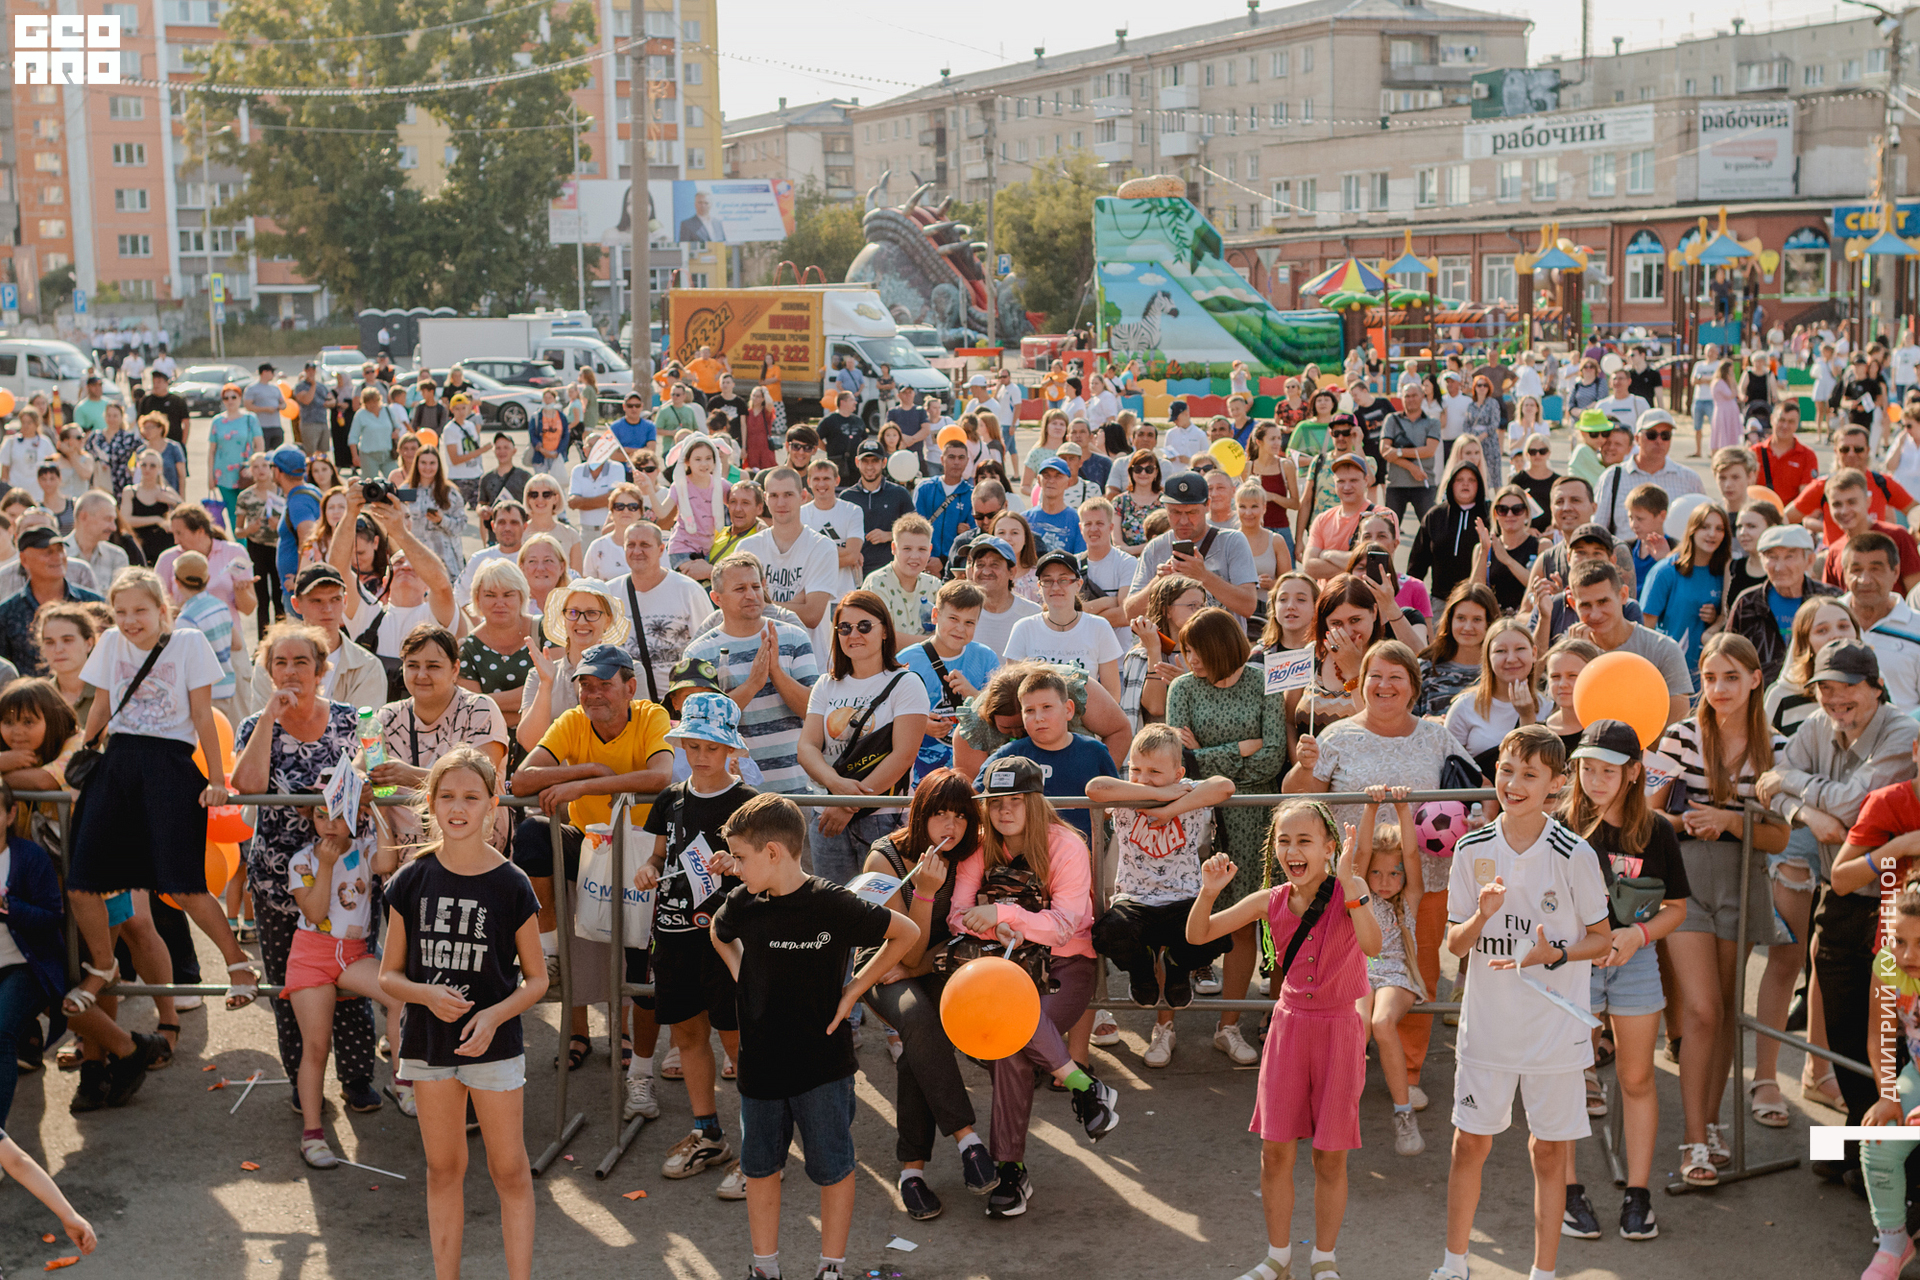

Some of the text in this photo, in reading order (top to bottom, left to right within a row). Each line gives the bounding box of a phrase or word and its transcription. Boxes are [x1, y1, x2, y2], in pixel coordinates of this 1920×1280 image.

[1702, 108, 1788, 132] рабочий
[1491, 117, 1607, 154] рабочий
[1267, 660, 1291, 675] INTER
[1131, 815, 1184, 856] MARVEL
[692, 846, 711, 871] INTER
[583, 877, 598, 894] LC
[419, 896, 478, 935] LET
[473, 906, 488, 940] your
[1505, 914, 1531, 934] Fly
